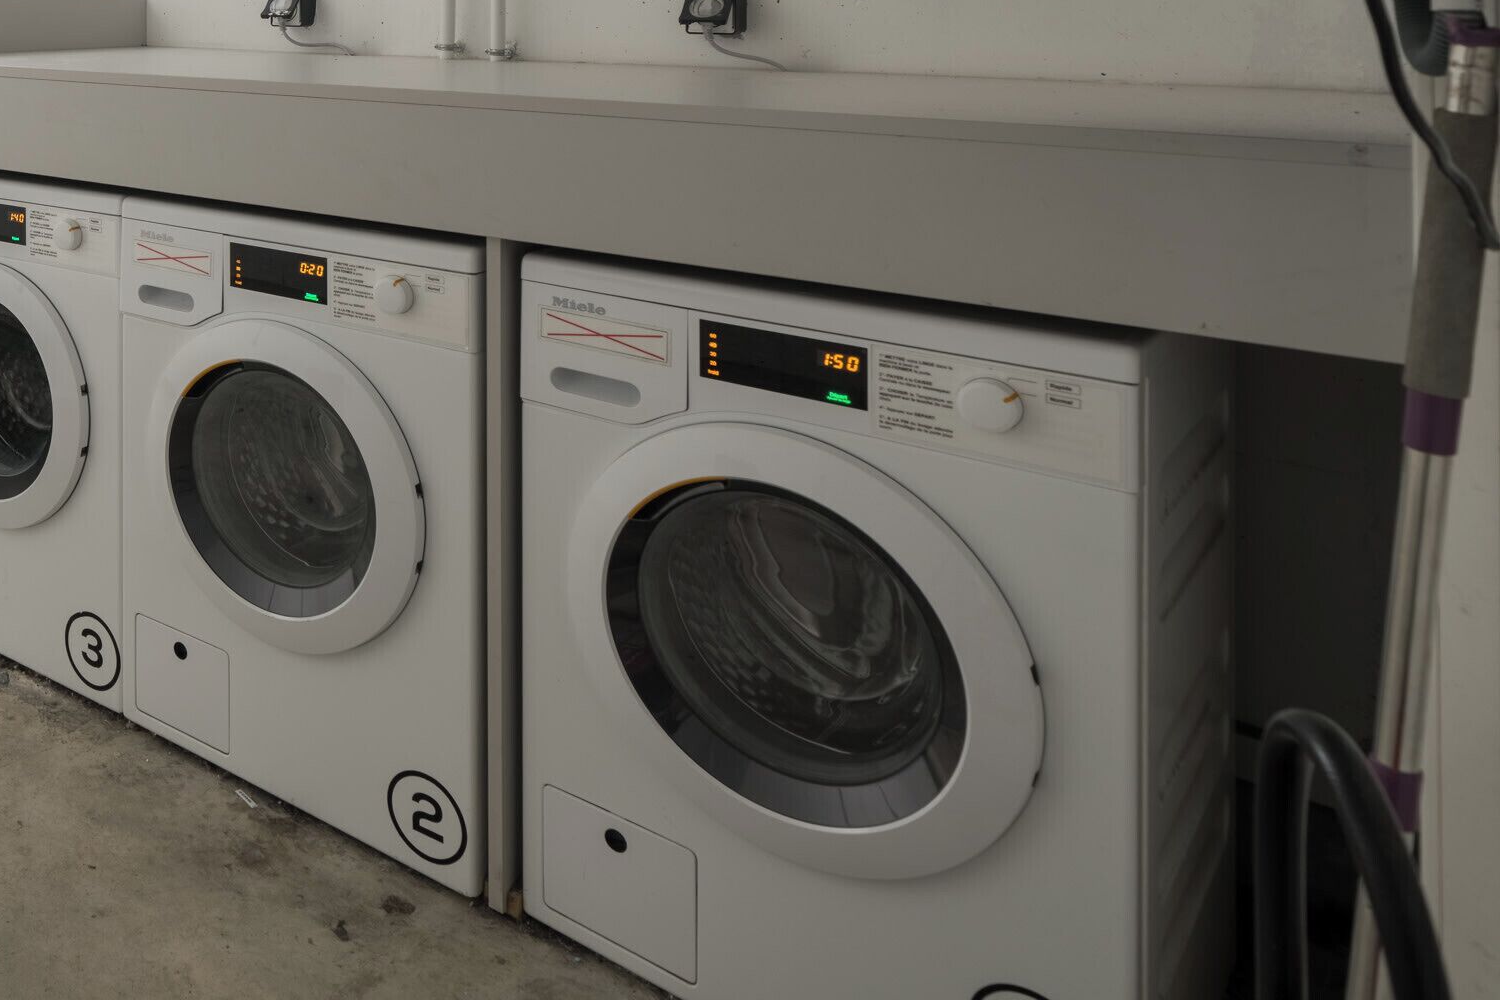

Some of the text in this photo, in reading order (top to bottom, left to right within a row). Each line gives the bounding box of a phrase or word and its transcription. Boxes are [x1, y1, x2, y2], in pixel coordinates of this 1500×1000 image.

[140, 229, 174, 243] Miele
[300, 262, 325, 277] 0:20
[552, 296, 606, 315] Miele
[824, 353, 860, 373] 1:50
[81, 628, 104, 669] 3
[411, 792, 445, 844] 2
